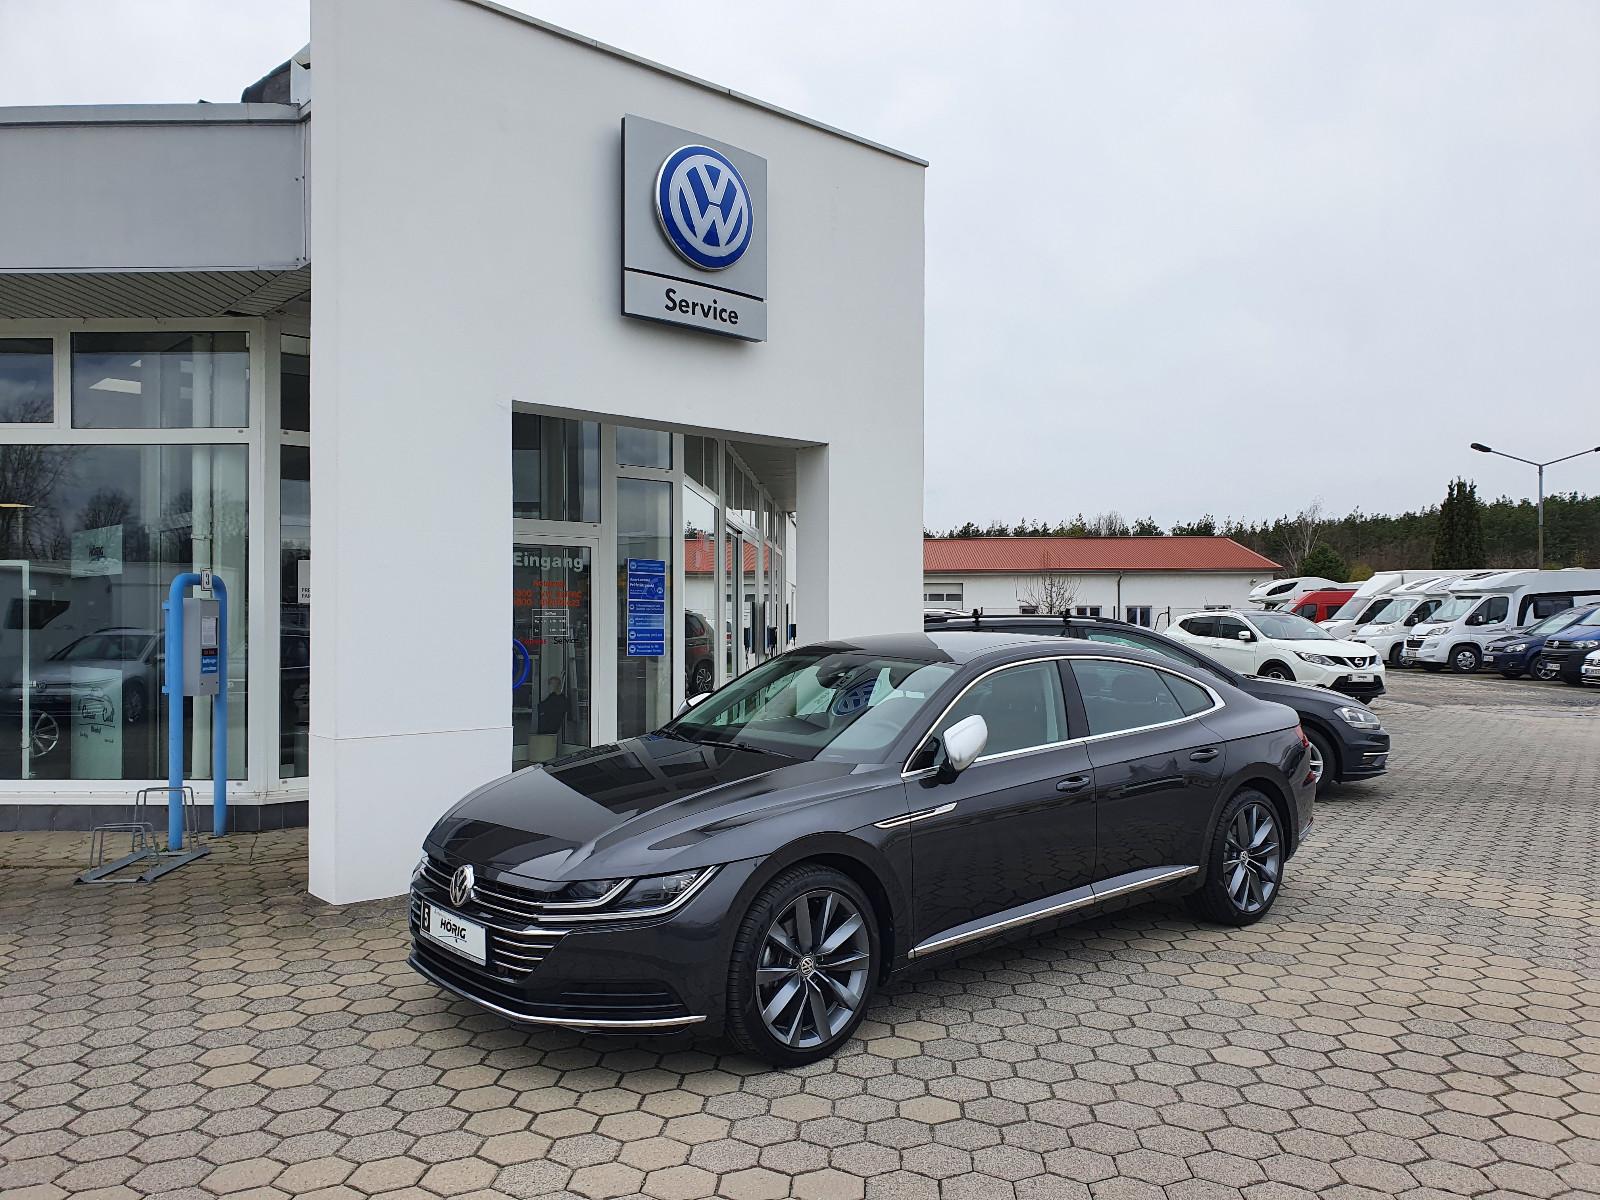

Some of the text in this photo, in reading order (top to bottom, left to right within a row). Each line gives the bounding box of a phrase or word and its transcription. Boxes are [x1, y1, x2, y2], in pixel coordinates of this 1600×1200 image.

[664, 288, 739, 325] Service
[513, 552, 584, 573] Eingang
[205, 573, 210, 585] 3
[440, 918, 467, 939] HÖRIG
